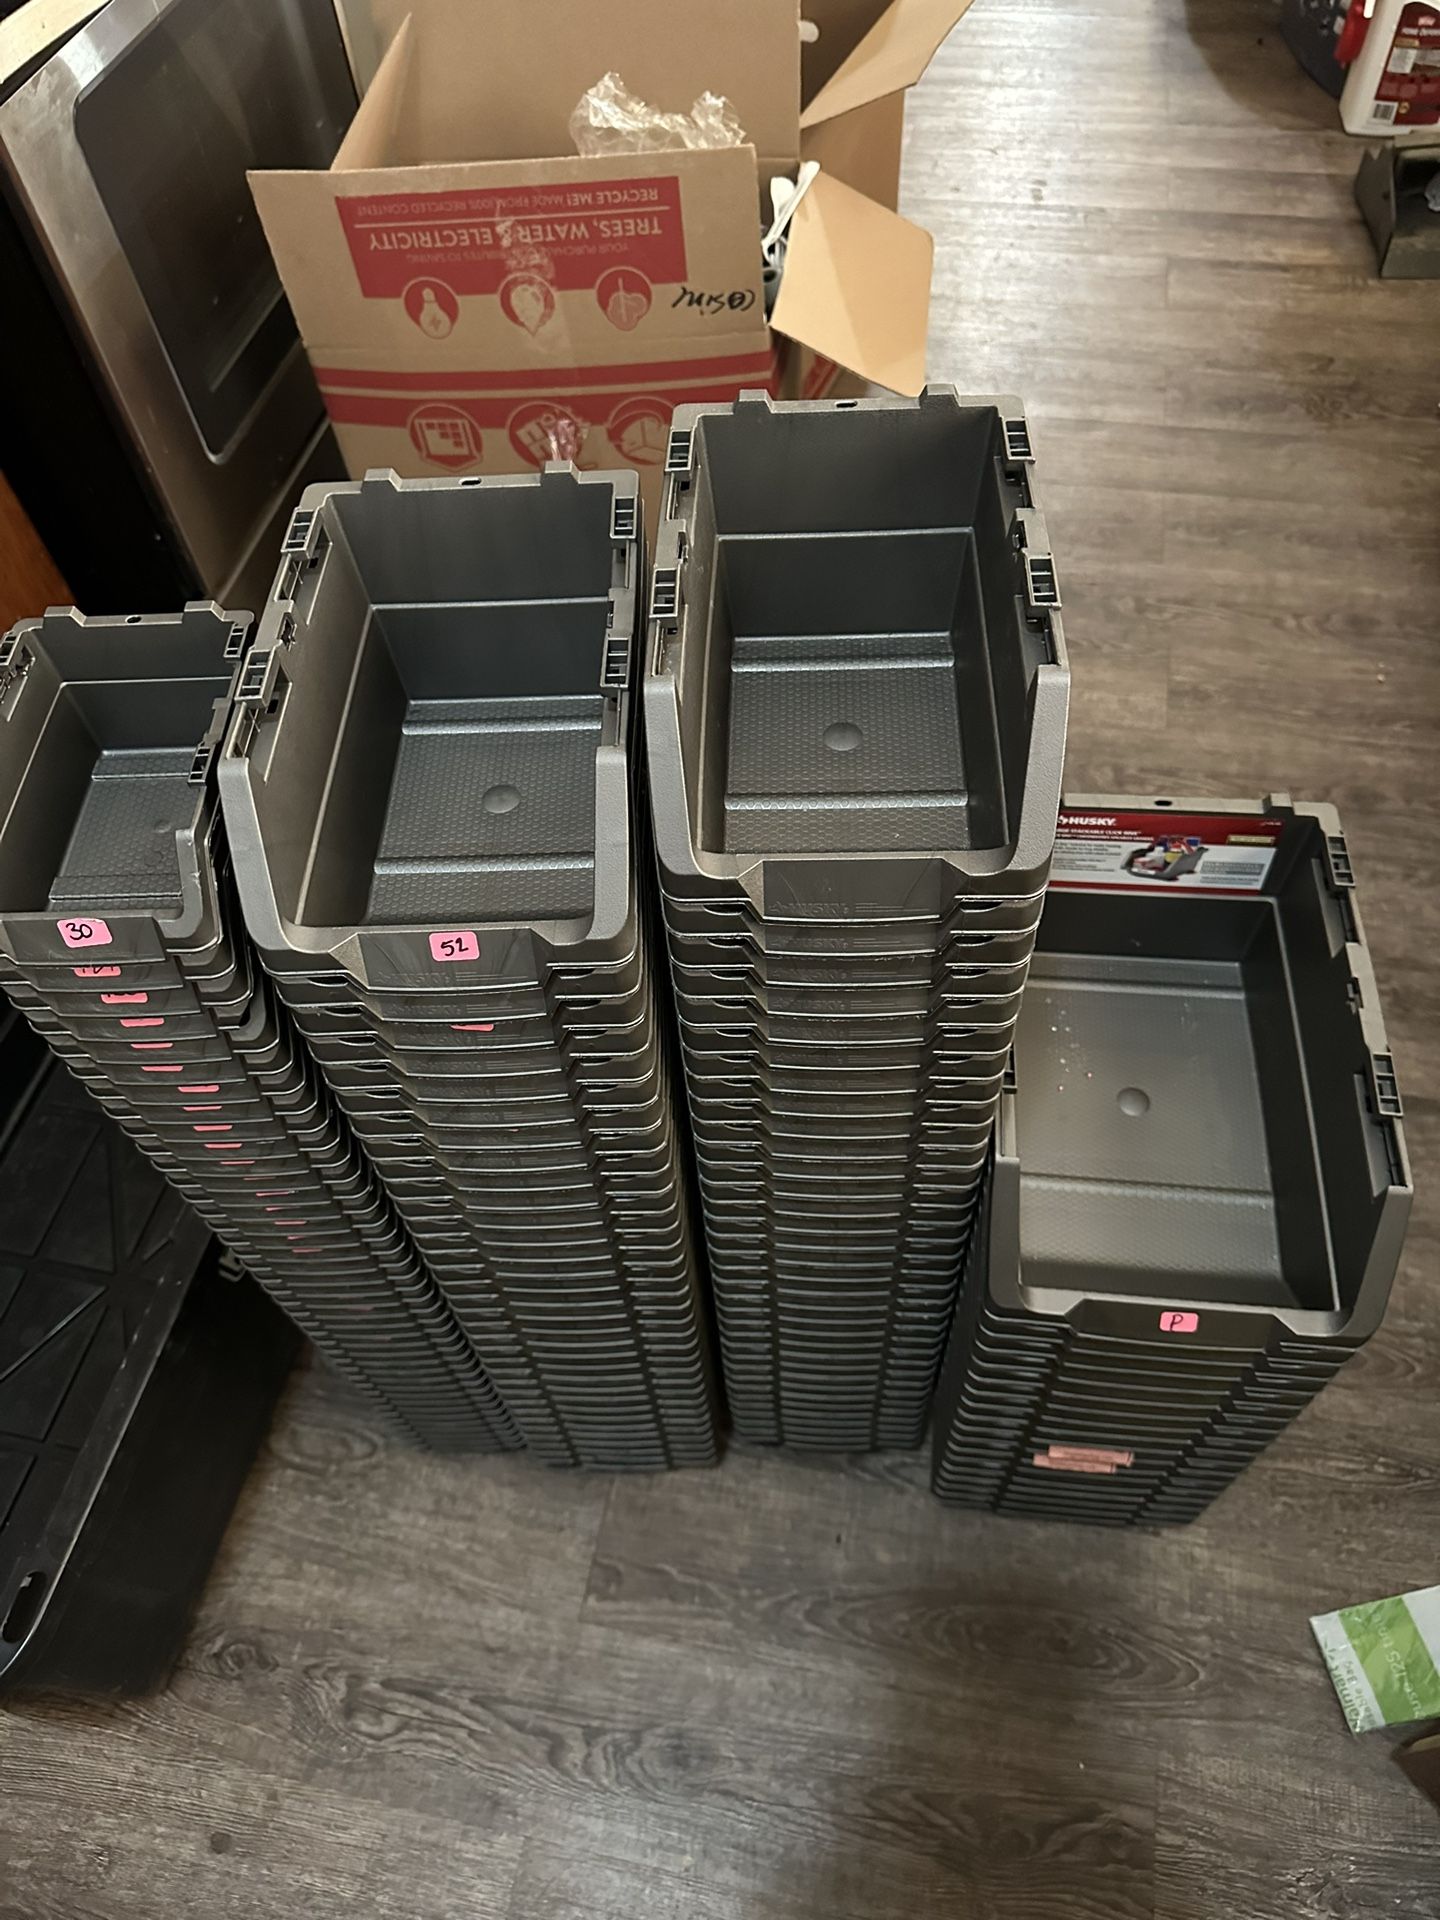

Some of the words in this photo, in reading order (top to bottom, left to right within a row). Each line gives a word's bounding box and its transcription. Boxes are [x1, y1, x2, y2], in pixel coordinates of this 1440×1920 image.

[566, 190, 594, 207] ME!
[596, 186, 659, 207] RECYCLE
[516, 221, 590, 244] WATER
[592, 215, 663, 237] TREES,
[369, 226, 492, 250] ELECTRICITY
[1068, 815, 1117, 826] HUSKY
[65, 922, 93, 941] 30
[439, 937, 469, 957] 52
[1169, 1313, 1184, 1332] P
